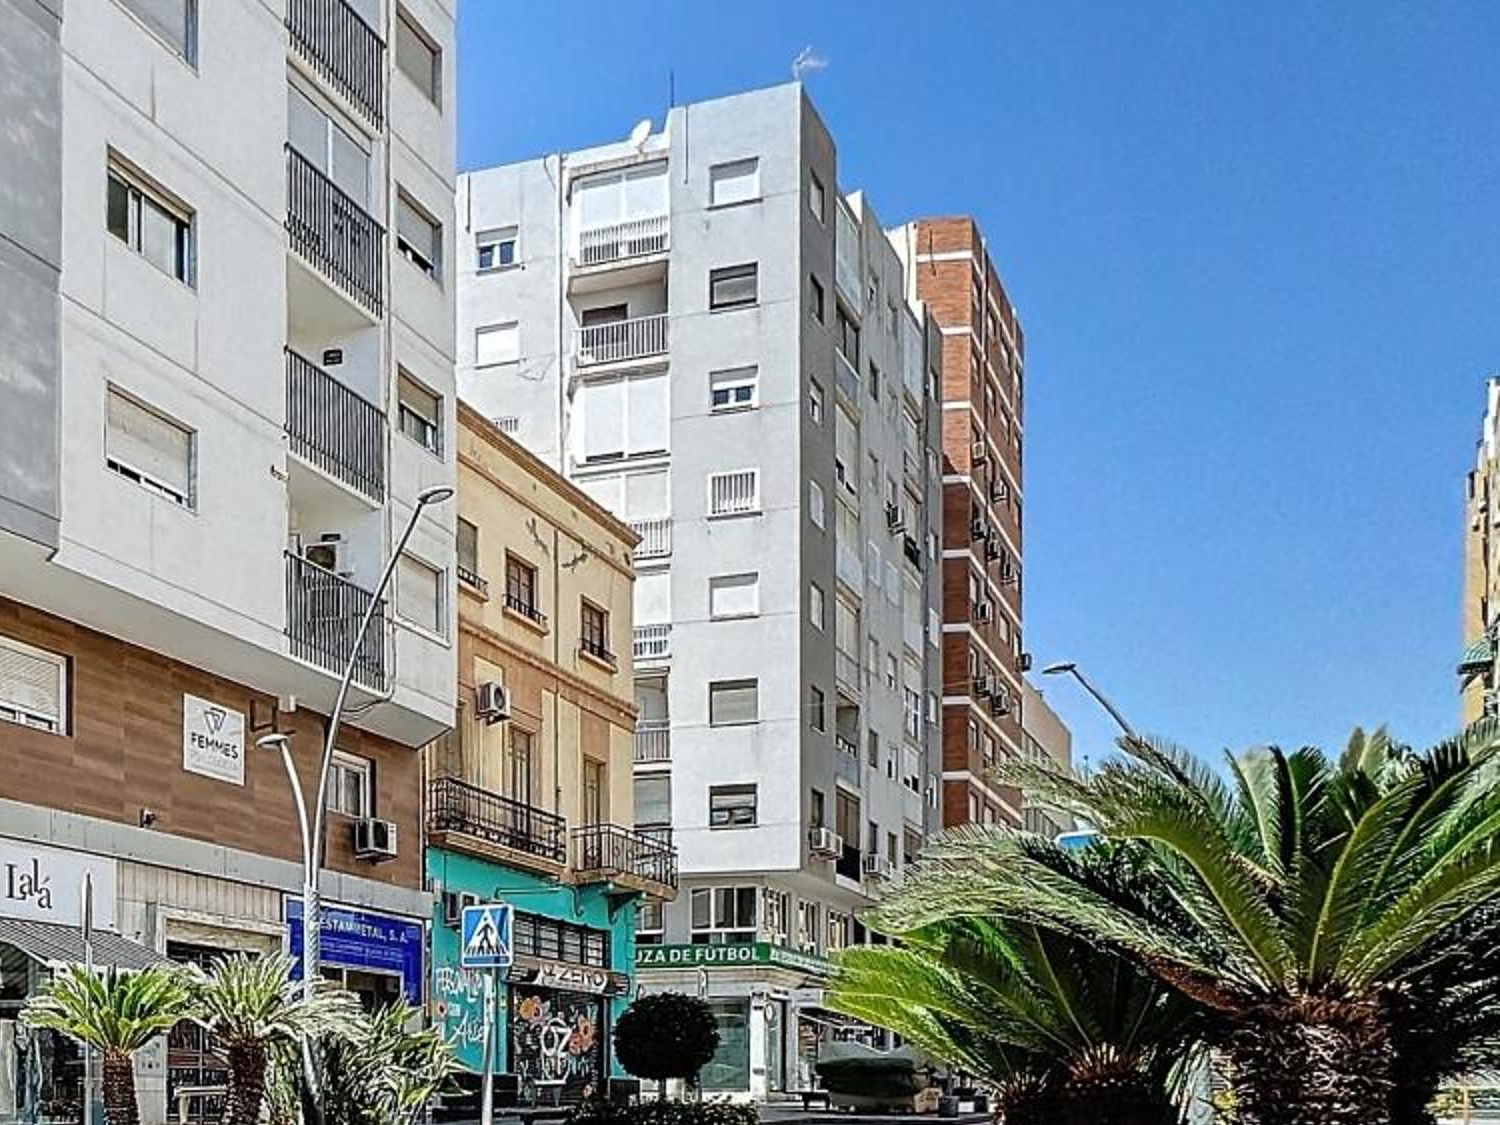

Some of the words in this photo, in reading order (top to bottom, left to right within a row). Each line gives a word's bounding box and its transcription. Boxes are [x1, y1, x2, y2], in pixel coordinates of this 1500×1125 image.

[190, 731, 239, 760] FEMMES
[4, 857, 53, 910] Lalá
[669, 949, 691, 962] DE
[695, 945, 761, 962] FÚTBOL
